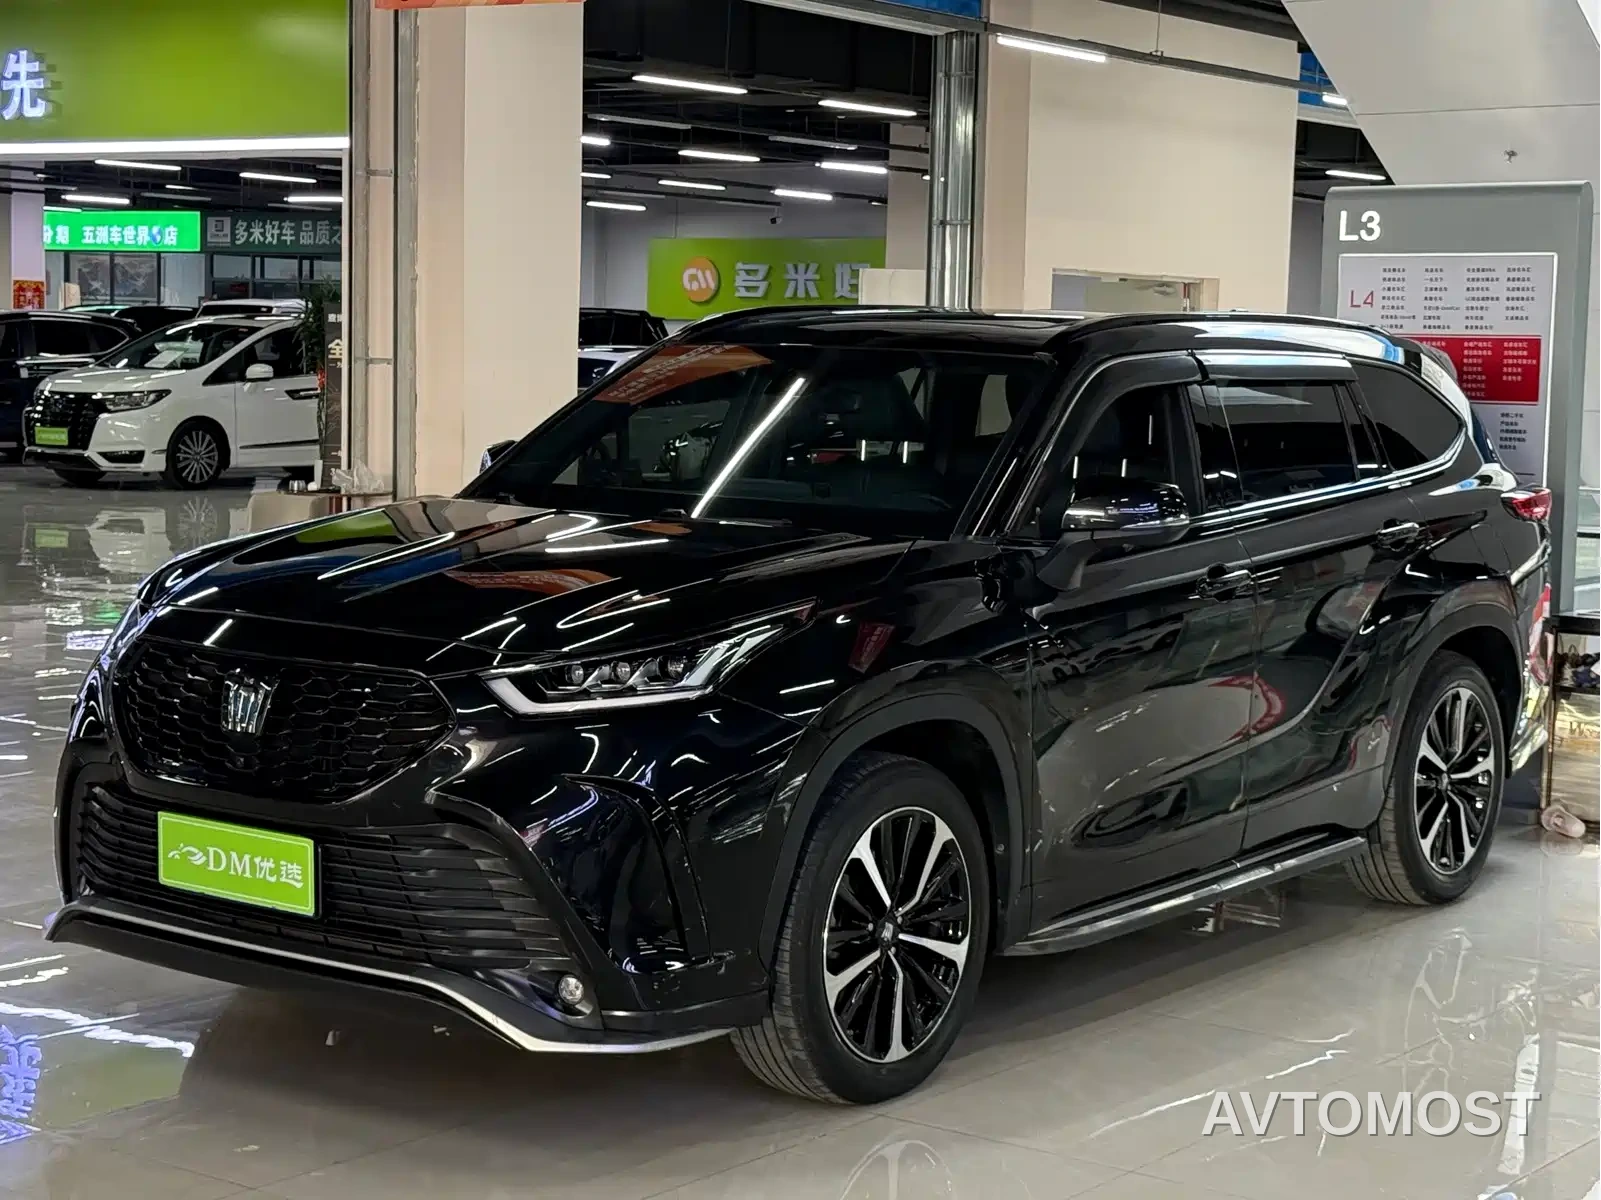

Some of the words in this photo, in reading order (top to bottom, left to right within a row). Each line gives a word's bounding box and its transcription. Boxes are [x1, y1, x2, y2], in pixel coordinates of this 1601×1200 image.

[2, 50, 46, 120] 先
[235, 219, 296, 246] 多米好车
[1339, 210, 1381, 241] L3
[1350, 290, 1374, 308] L4
[206, 847, 304, 889] DM优选
